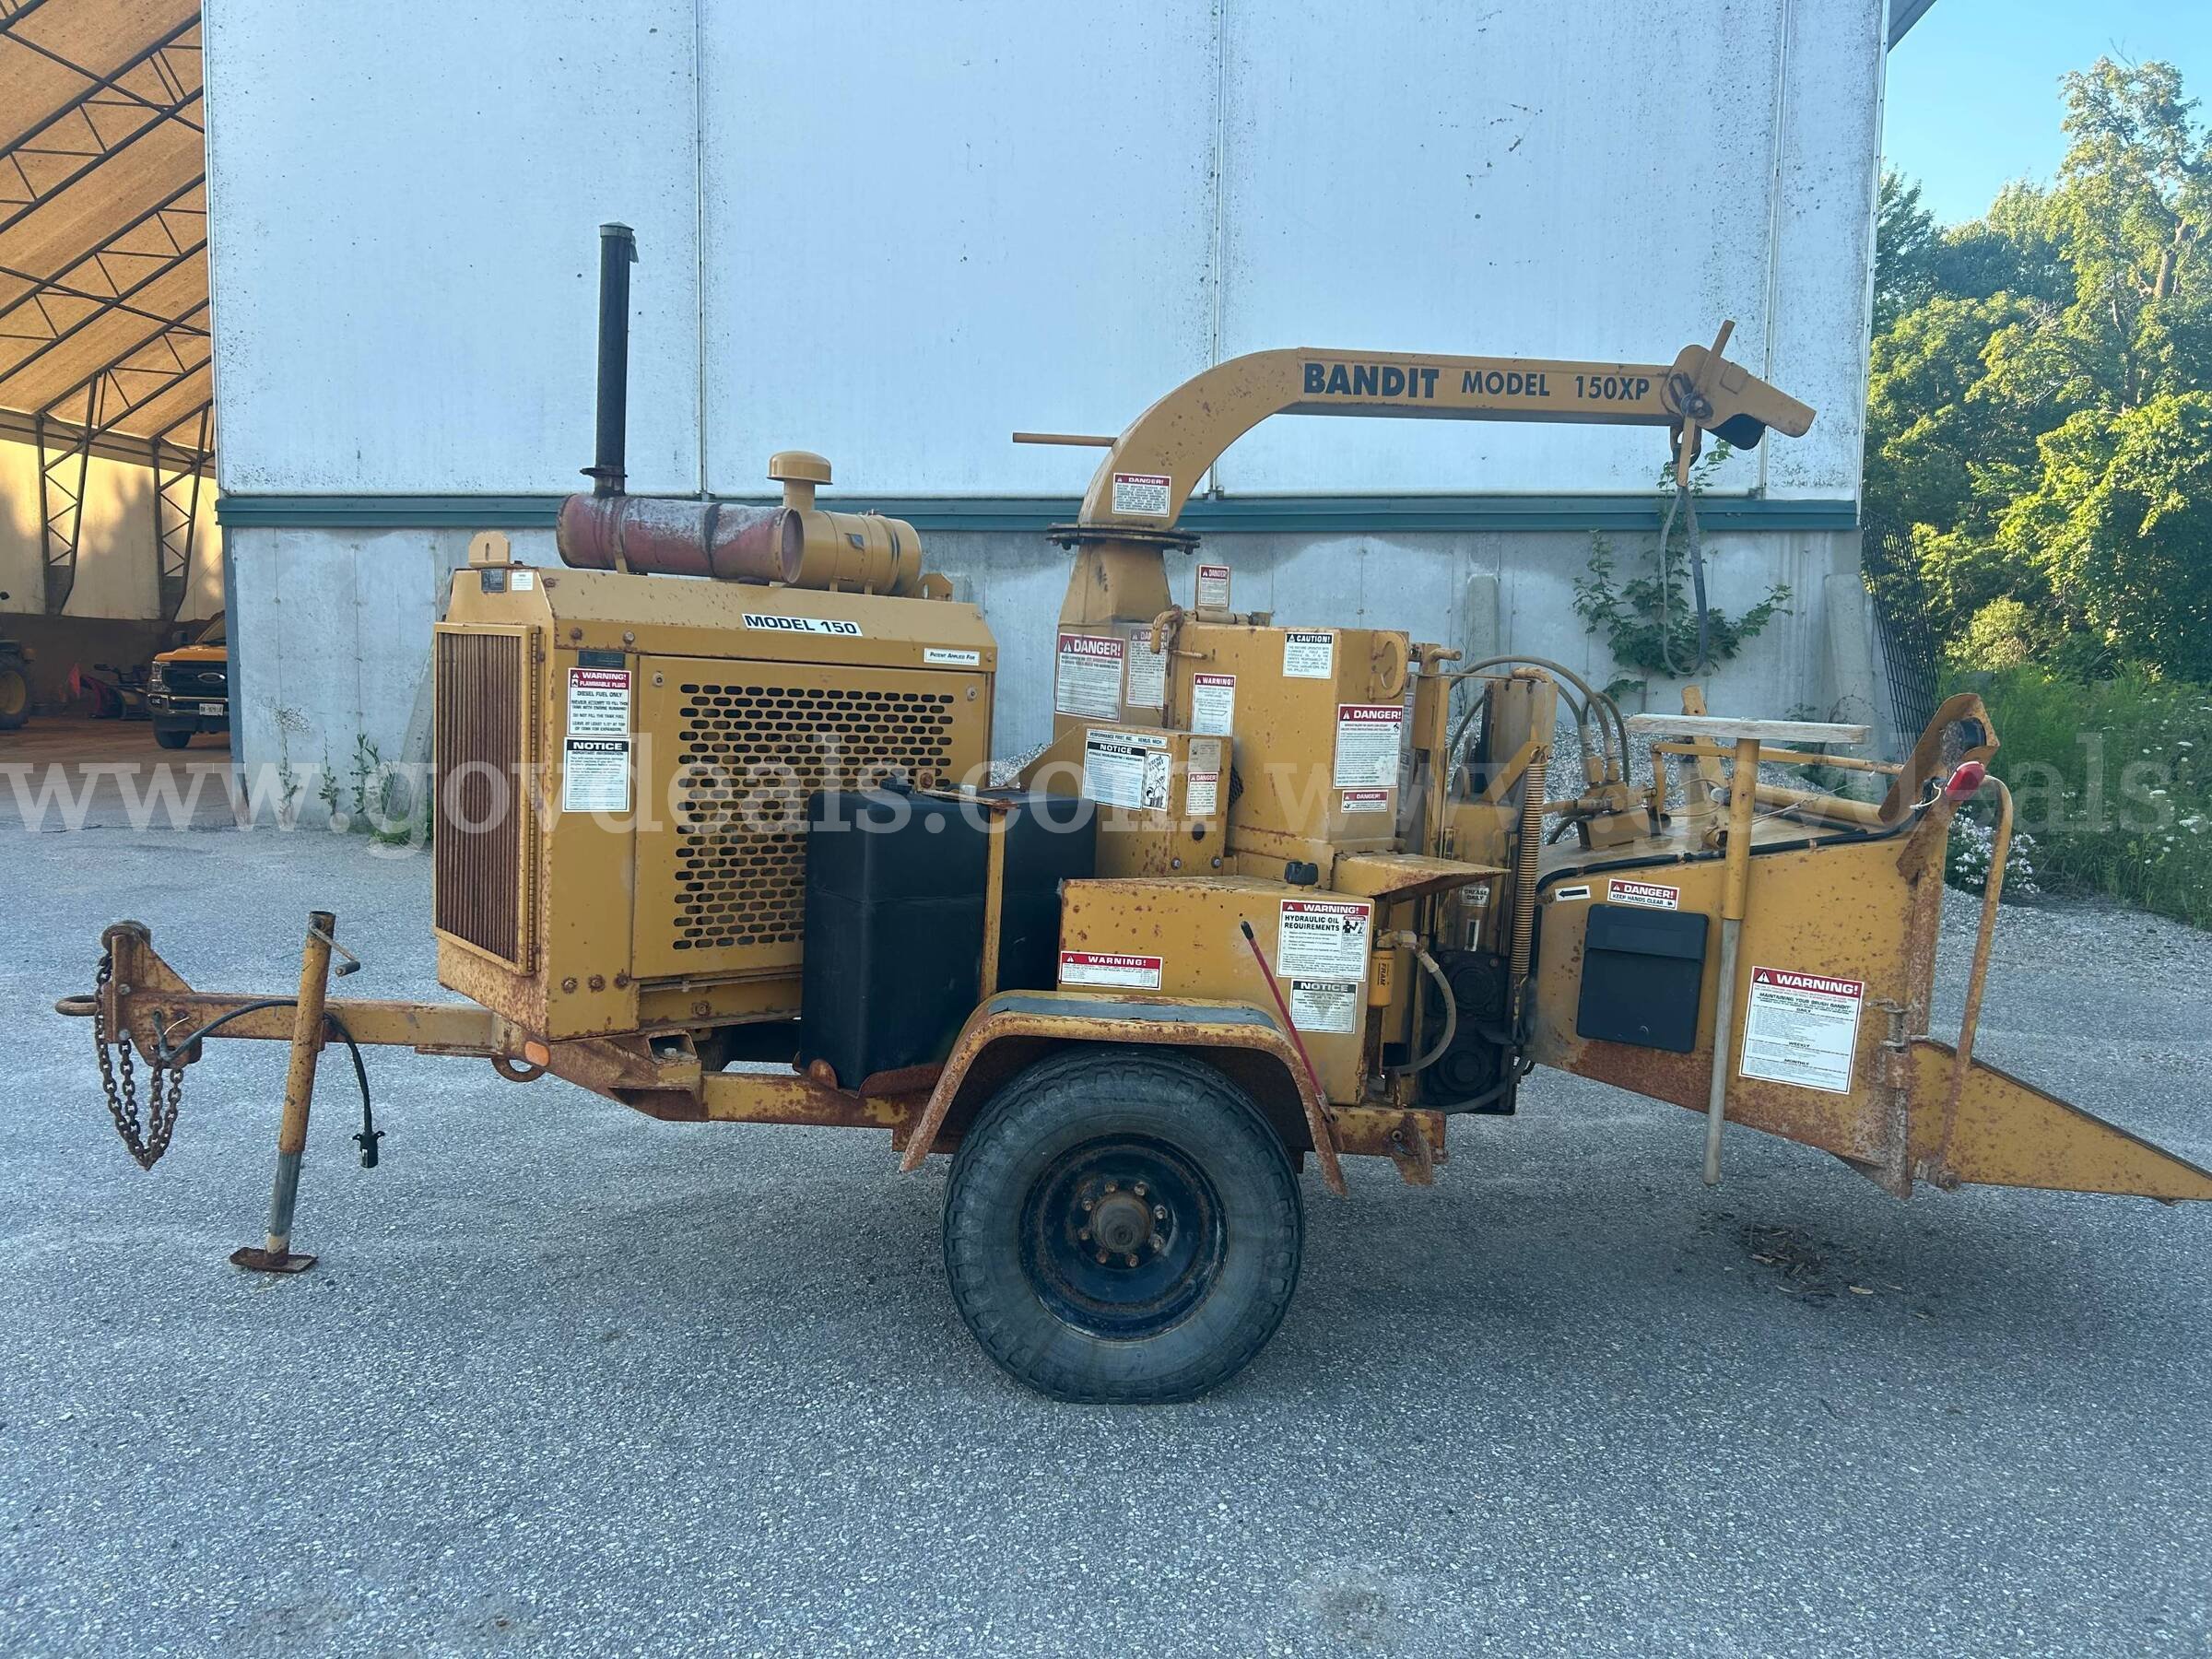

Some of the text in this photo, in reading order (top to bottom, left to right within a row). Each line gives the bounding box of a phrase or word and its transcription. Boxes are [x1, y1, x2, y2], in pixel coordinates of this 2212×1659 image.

[1302, 362, 1650, 402] BANDIT MODEL 150XP
[744, 615, 857, 634] MODEL 150
[1296, 635, 1330, 643] CAUTION!
[1073, 639, 1121, 656] DANGER!
[582, 672, 627, 681] WARNING!
[1202, 677, 1234, 686] WARNING!
[1353, 710, 1402, 720] DANGER!
[572, 741, 623, 751] NOTICE
[1100, 744, 1133, 755] NOTICE
[1623, 884, 1675, 900] DANGER!
[1627, 895, 1645, 903] HANDS
[1302, 903, 1359, 914] WARNING!
[1284, 914, 1339, 924] HYDRAULIC OIL
[1284, 922, 1340, 932] REQUIREMENTS
[1088, 955, 1147, 966] WARNING!
[1300, 982, 1348, 992] NOTICE
[1776, 973, 1859, 995] WARNING!
